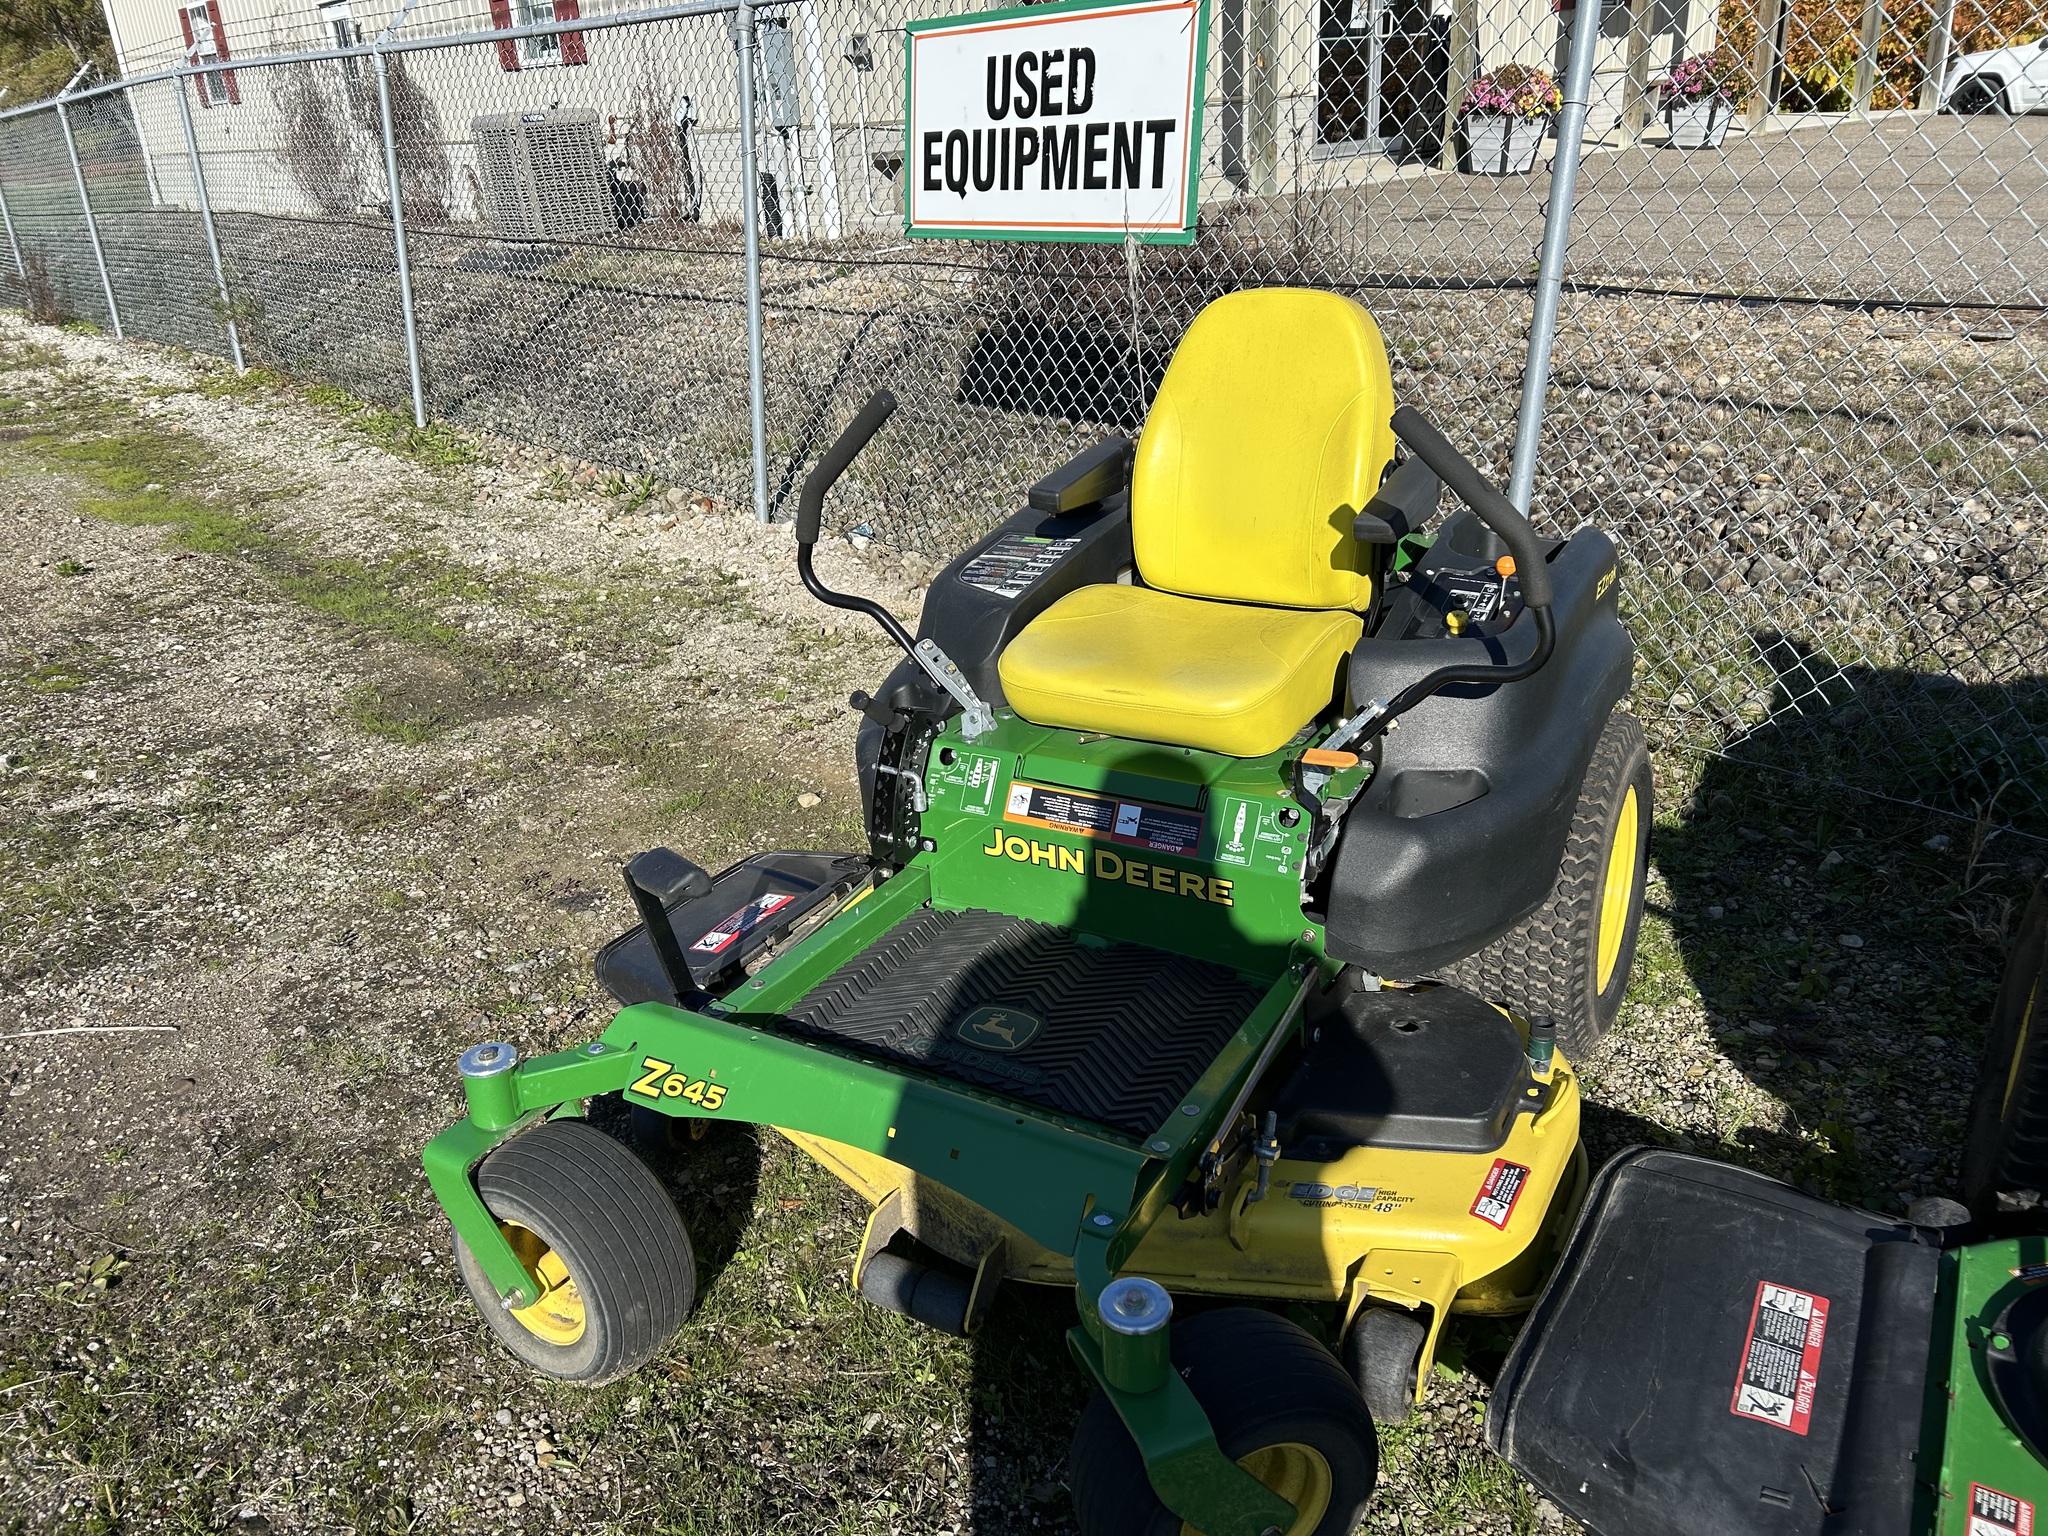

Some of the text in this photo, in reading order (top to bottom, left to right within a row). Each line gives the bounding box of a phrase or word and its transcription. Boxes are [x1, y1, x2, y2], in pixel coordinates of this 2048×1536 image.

[986, 46, 1096, 120] USED
[923, 119, 1176, 200] EQUIPMENT
[1048, 822, 1080, 833] WARNING
[1149, 841, 1175, 852] DANGER
[983, 828, 1085, 875] JOHN
[1094, 847, 1235, 907] DEERE
[900, 1034, 1042, 1085] JOHN DEERE
[628, 1055, 729, 1112] Z645
[1288, 1182, 1379, 1203] EDGE
[1486, 1167, 1500, 1185] DANGER
[1376, 1195, 1415, 1204] CAPACITY
[1808, 1317, 1824, 1348] DANGER
[1795, 1380, 1815, 1415] PELIGRO
